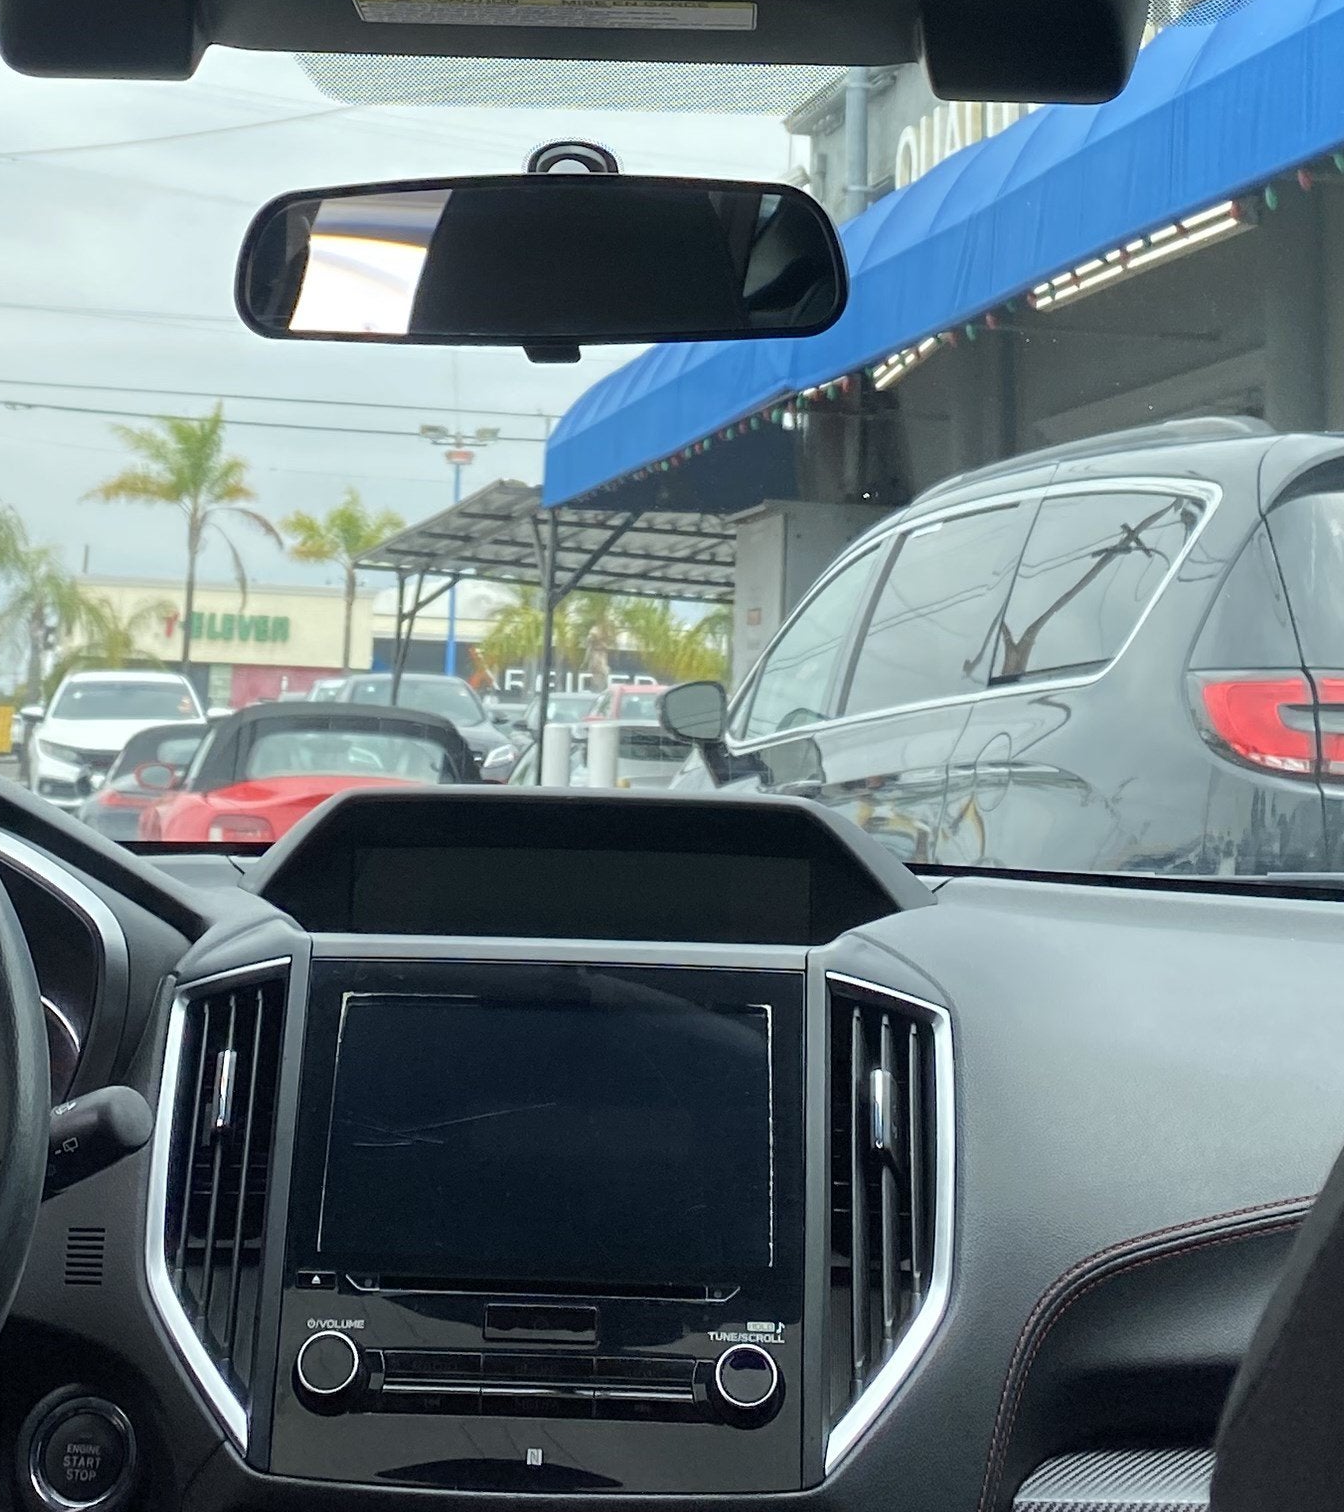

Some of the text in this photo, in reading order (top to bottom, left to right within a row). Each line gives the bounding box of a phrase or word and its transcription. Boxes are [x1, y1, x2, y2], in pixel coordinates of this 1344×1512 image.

[707, 1331, 786, 1344] TUNE/SCROLL
[66, 1443, 102, 1456] ENGINE
[62, 1455, 102, 1469] START
[66, 1468, 97, 1482] STOP
